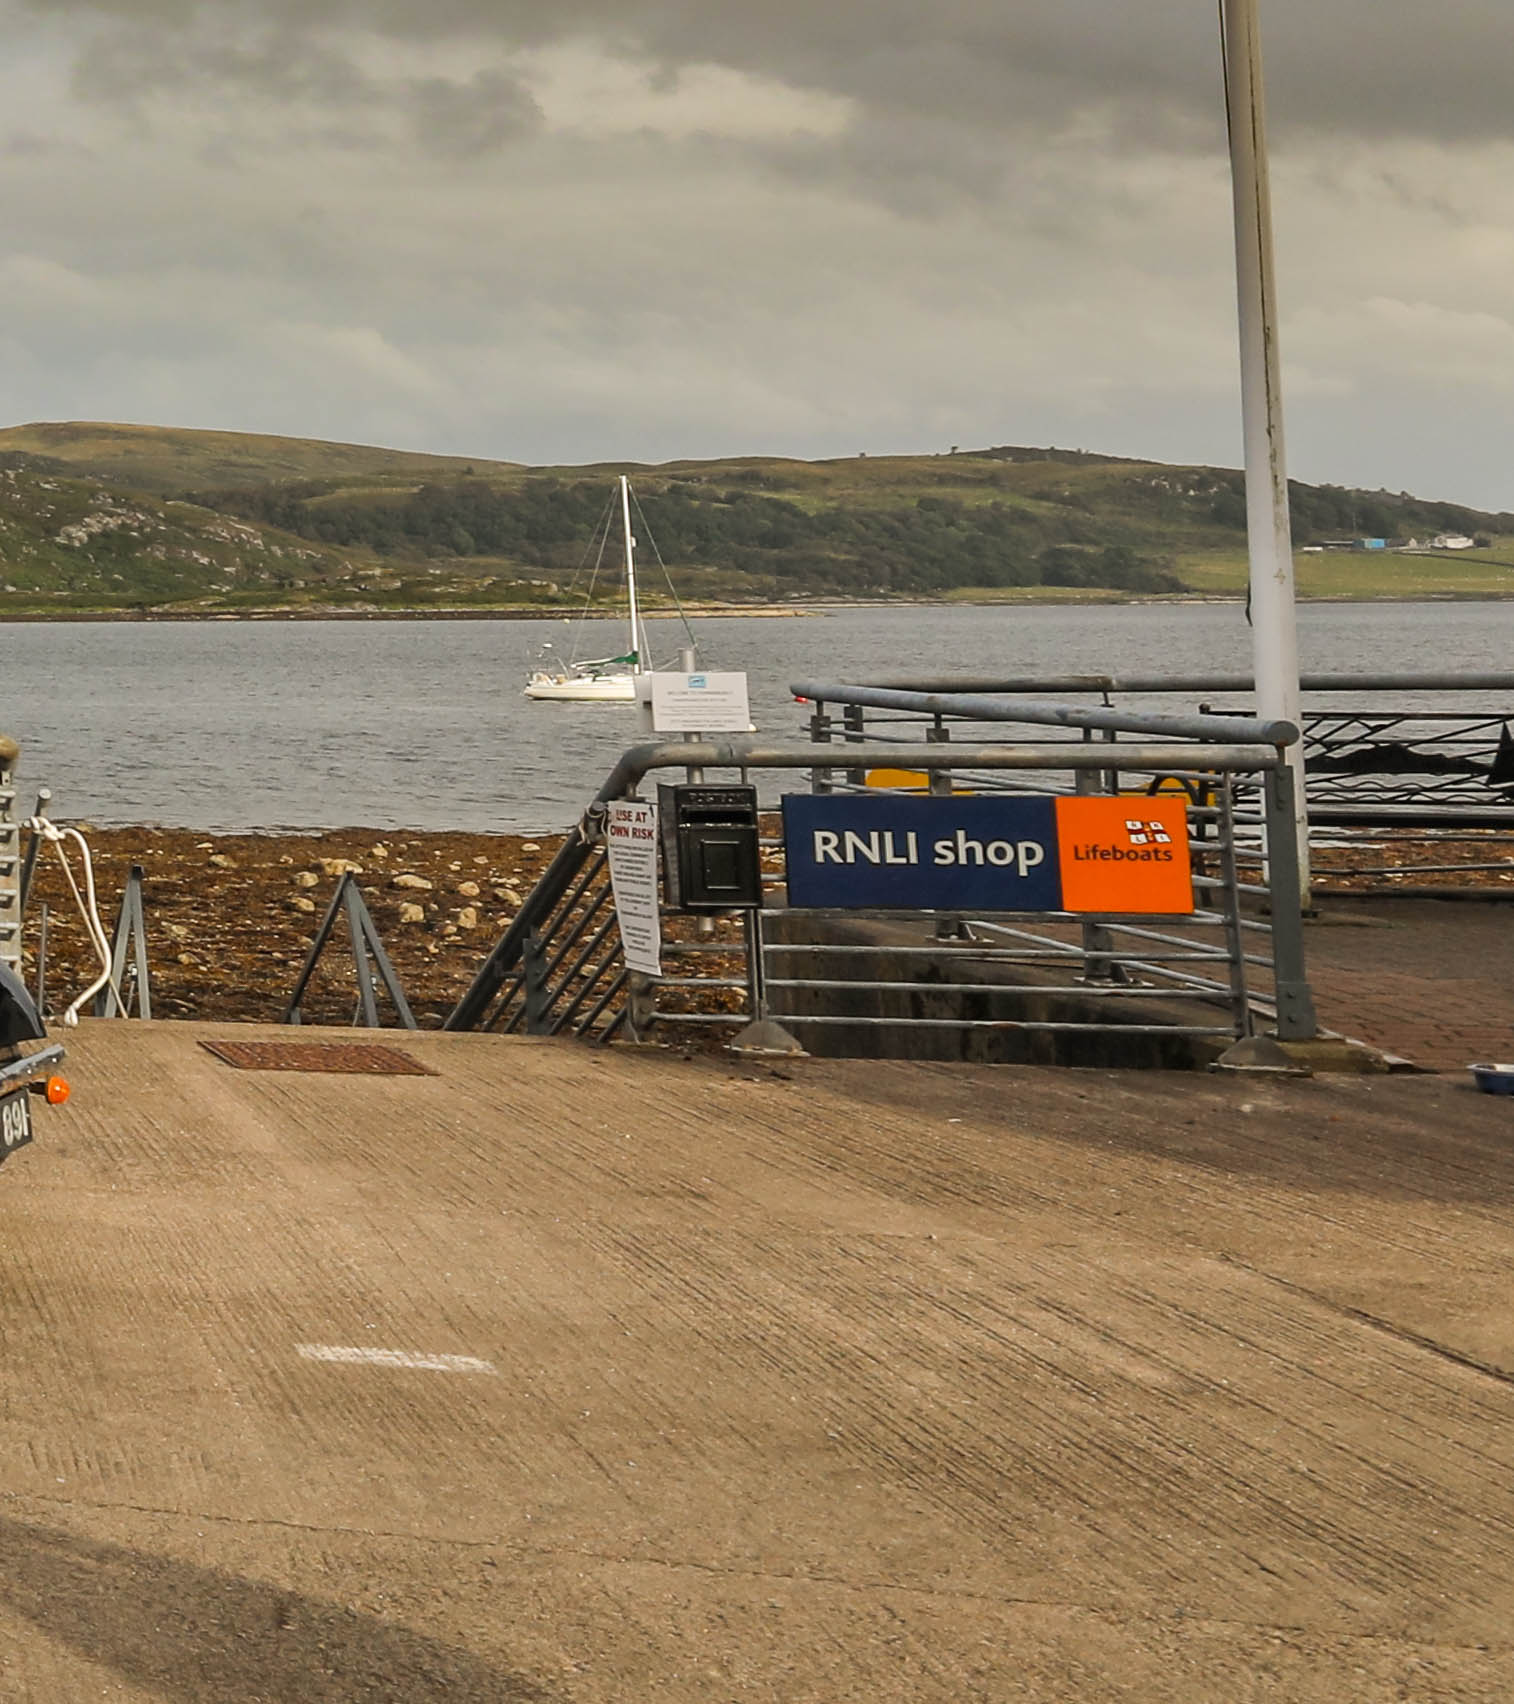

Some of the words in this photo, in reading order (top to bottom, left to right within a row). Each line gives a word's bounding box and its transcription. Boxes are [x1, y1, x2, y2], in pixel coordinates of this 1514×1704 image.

[616, 809, 633, 822] USE
[635, 812, 648, 823] AT
[610, 825, 630, 838] OWN
[632, 827, 655, 841] RISK
[812, 830, 919, 865] RNLI
[933, 829, 1044, 877] shop
[1073, 844, 1173, 863] Lifeboats
[2, 1098, 29, 1146] 891
